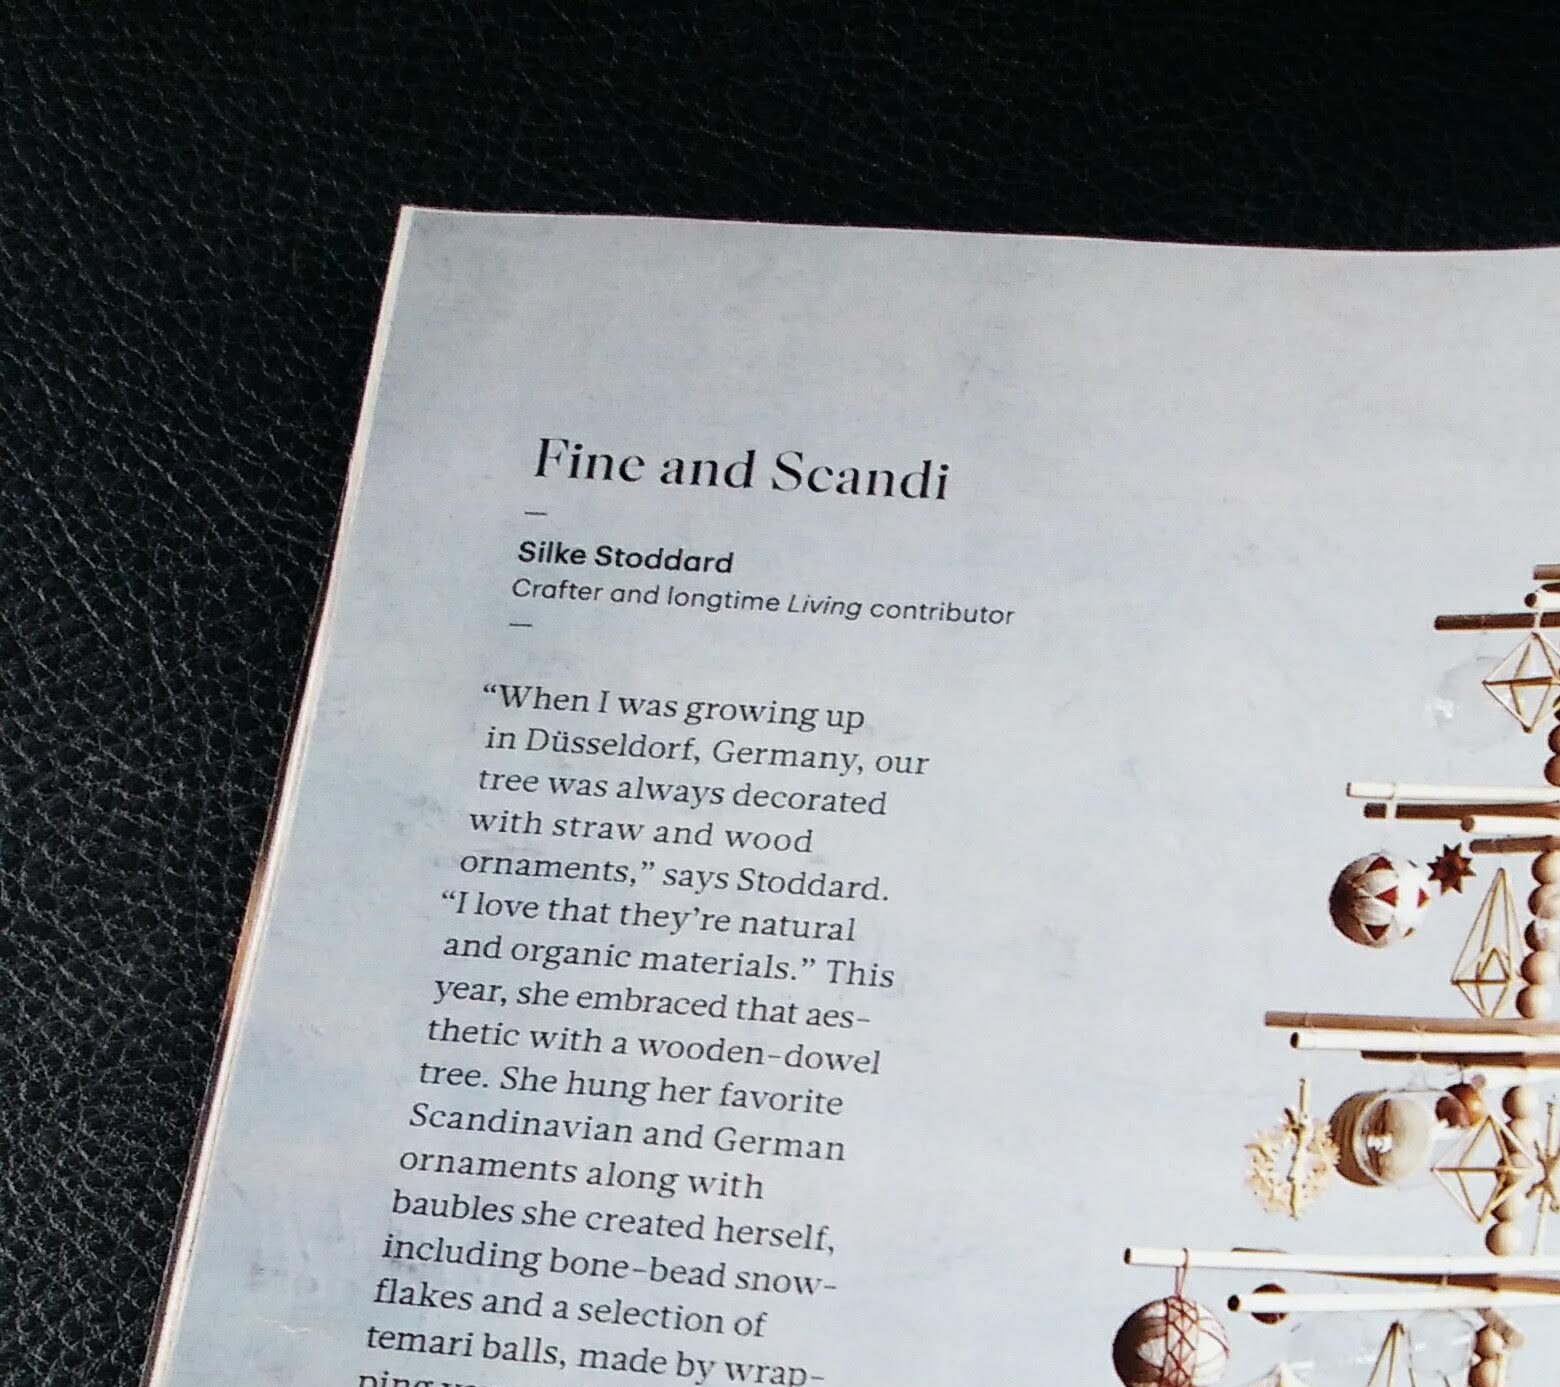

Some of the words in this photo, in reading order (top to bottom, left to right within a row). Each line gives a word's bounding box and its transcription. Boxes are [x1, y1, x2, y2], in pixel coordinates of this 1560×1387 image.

[532, 436, 647, 484] Fine
[658, 447, 758, 490] and
[769, 449, 951, 502] Scandi
[516, 539, 589, 567] Silke
[592, 543, 736, 575] Stoddard
[510, 576, 606, 602] Crafter
[608, 583, 662, 607] and
[665, 583, 782, 614] longtime
[785, 592, 864, 622] Living
[868, 600, 1017, 626] contributor
[481, 681, 591, 714] “When
[596, 688, 612, 715] I
[616, 695, 680, 719] was
[681, 698, 822, 734] growing
[824, 708, 866, 737] up
[483, 724, 518, 751] in
[523, 726, 702, 767] Düsseldorf,
[711, 738, 865, 779] Germany,
[874, 753, 932, 776] our
[478, 768, 541, 794] tree
[546, 775, 610, 799] was
[614, 774, 727, 812] always
[731, 781, 889, 817] decorated
[467, 808, 544, 837] with
[550, 815, 647, 843] straw
[651, 820, 715, 848] and
[723, 827, 815, 855] wood
[458, 854, 657, 889] ornaments,”
[661, 867, 731, 897] says
[735, 866, 890, 903] Stoddard.
[440, 888, 471, 916] “I
[472, 889, 541, 921] love
[546, 895, 613, 926] that
[618, 900, 733, 937] they’re
[736, 914, 857, 943] natural
[441, 933, 504, 961] and
[509, 941, 634, 972] organic
[636, 950, 818, 982] materials.”
[825, 958, 896, 990] This
[431, 978, 509, 1009] year,
[514, 979, 571, 1009] she
[574, 985, 729, 1020] embraced
[735, 994, 801, 1026] that
[804, 1006, 872, 1030] aes-
[426, 1015, 522, 1048] thetic
[528, 1025, 604, 1055] with
[609, 1035, 629, 1056] a
[636, 1036, 882, 1076] wooden-dowel
[418, 1061, 490, 1090] tree.
[498, 1064, 559, 1095] She
[562, 1068, 653, 1109] hung
[654, 1074, 714, 1106] her
[716, 1080, 845, 1117] favorite
[407, 1101, 634, 1145] Scandinavian
[641, 1122, 706, 1151] and
[712, 1125, 847, 1163] German
[398, 1150, 580, 1185] ornaments
[584, 1160, 682, 1201] along
[686, 1170, 765, 1201] with
[390, 1186, 516, 1224] baubles
[519, 1198, 578, 1230] she
[583, 1210, 706, 1242] created
[712, 1214, 836, 1258] herself,
[379, 1231, 544, 1280] including
[548, 1245, 728, 1290] bone-bead
[733, 1269, 839, 1297] snow-
[371, 1276, 475, 1312] flakes
[479, 1290, 545, 1319] and
[550, 1298, 570, 1322] a
[575, 1296, 726, 1336] selection
[732, 1310, 770, 1339] of
[365, 1324, 476, 1359] temari
[481, 1330, 568, 1372] balls,
[575, 1345, 669, 1376] made
[674, 1348, 719, 1387] by
